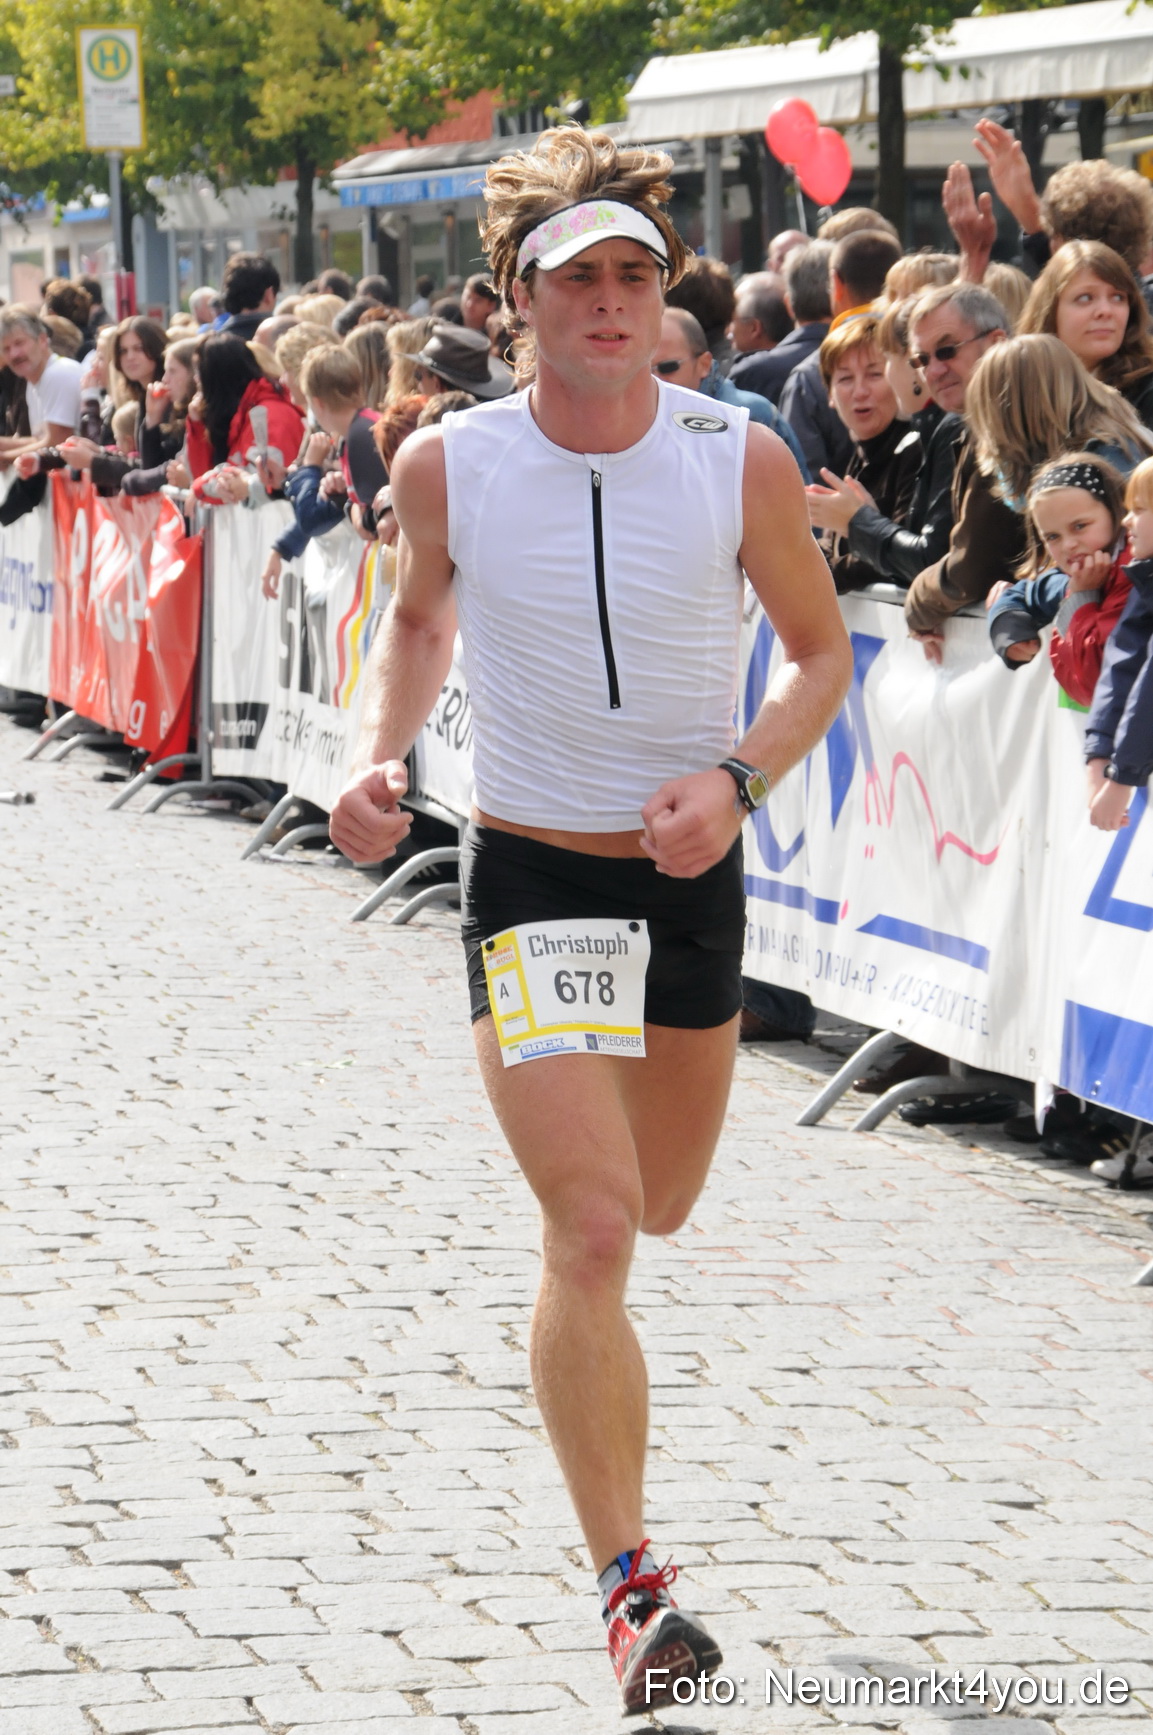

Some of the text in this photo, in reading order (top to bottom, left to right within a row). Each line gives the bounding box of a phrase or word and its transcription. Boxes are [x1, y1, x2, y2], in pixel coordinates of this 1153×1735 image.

[100, 44, 119, 70] H
[528, 932, 628, 960] Christoph
[500, 982, 509, 999] A
[554, 970, 615, 1006] 678
[597, 1034, 642, 1048] PFLEIDERER
